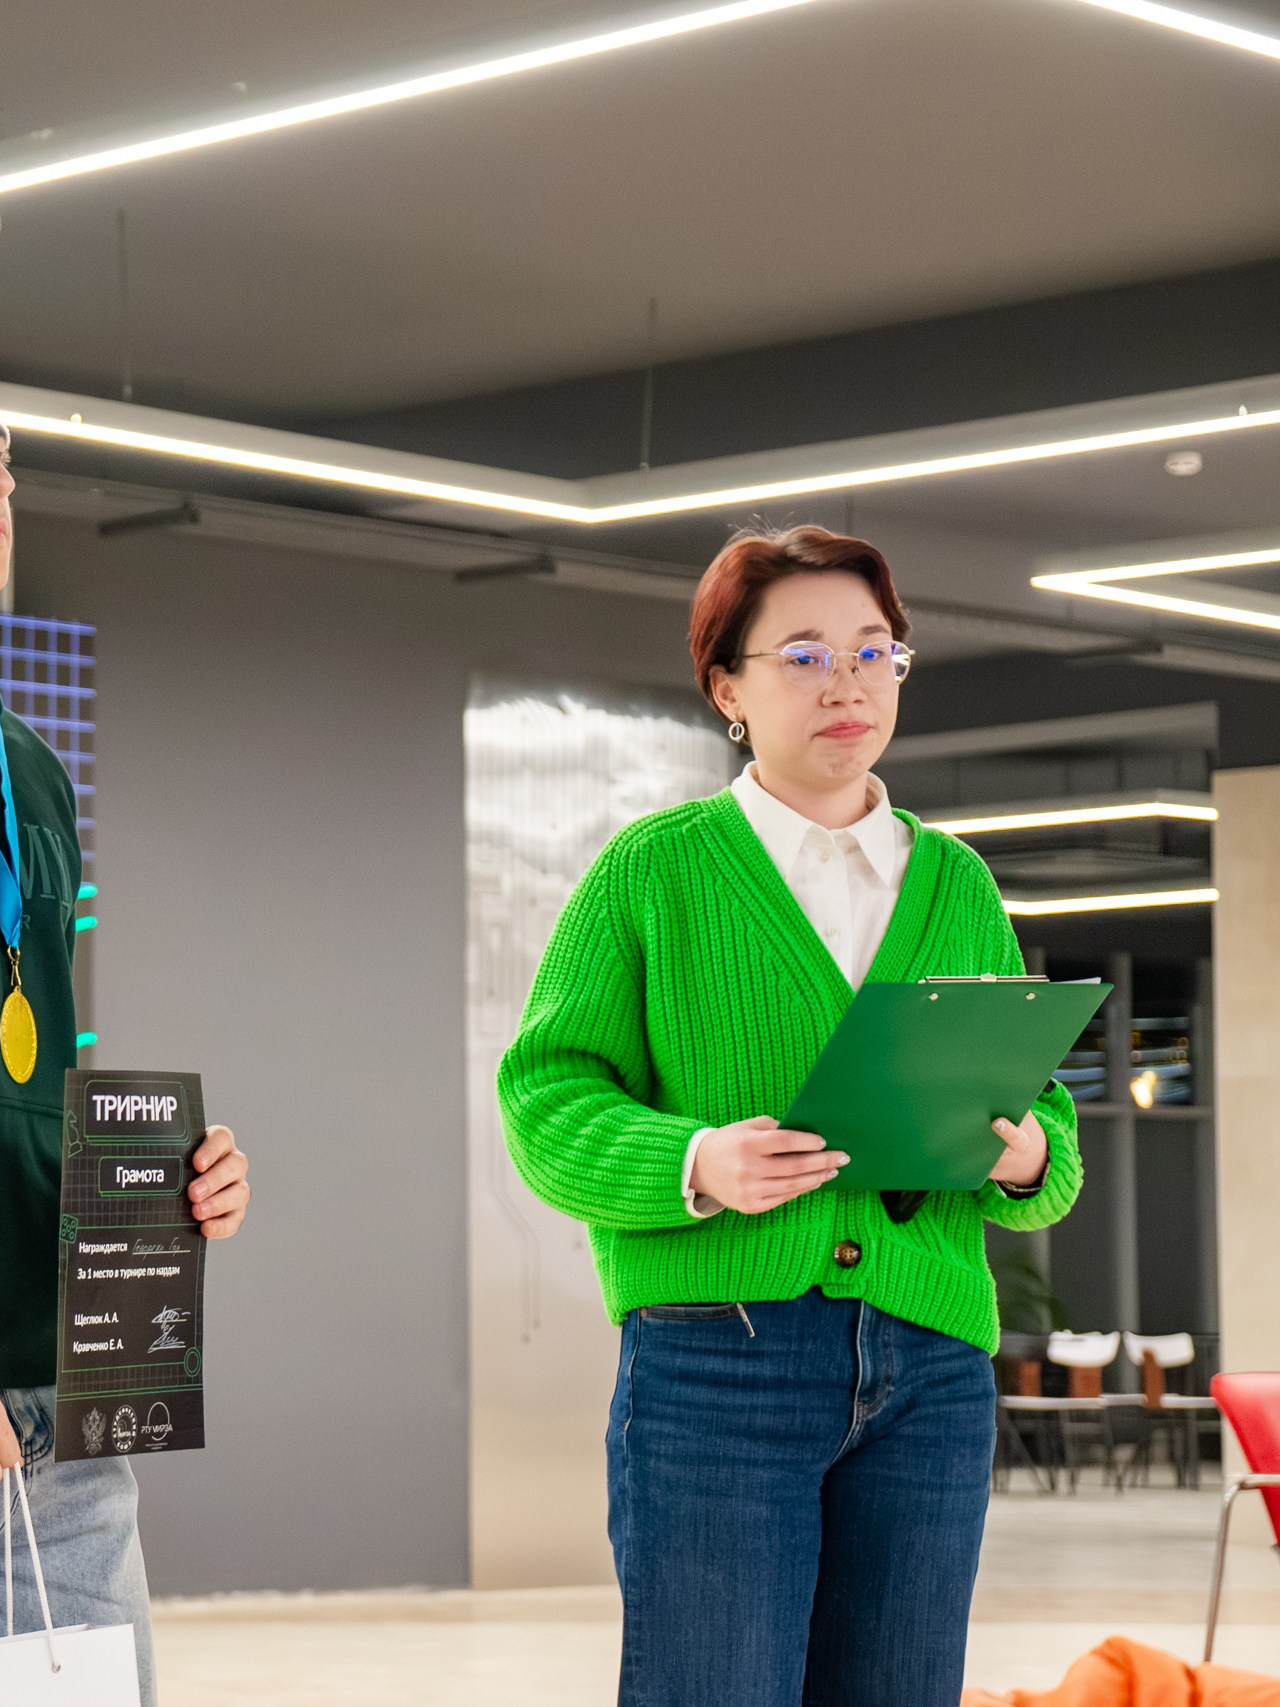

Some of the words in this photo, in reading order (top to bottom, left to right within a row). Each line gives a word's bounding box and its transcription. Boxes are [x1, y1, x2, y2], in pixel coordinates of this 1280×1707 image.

[92, 1094, 178, 1122] ТРИРНИР
[116, 1166, 165, 1189] Грамота
[78, 1241, 128, 1256] Награждается
[77, 1268, 86, 1280] За
[87, 1268, 92, 1280] 1
[93, 1269, 114, 1279] место
[114, 1269, 119, 1278] в
[120, 1267, 146, 1279] турнире
[147, 1267, 156, 1276] по
[156, 1266, 181, 1278] нардам
[74, 1313, 103, 1327] Щеглюк
[73, 1341, 109, 1355] Кравченко
